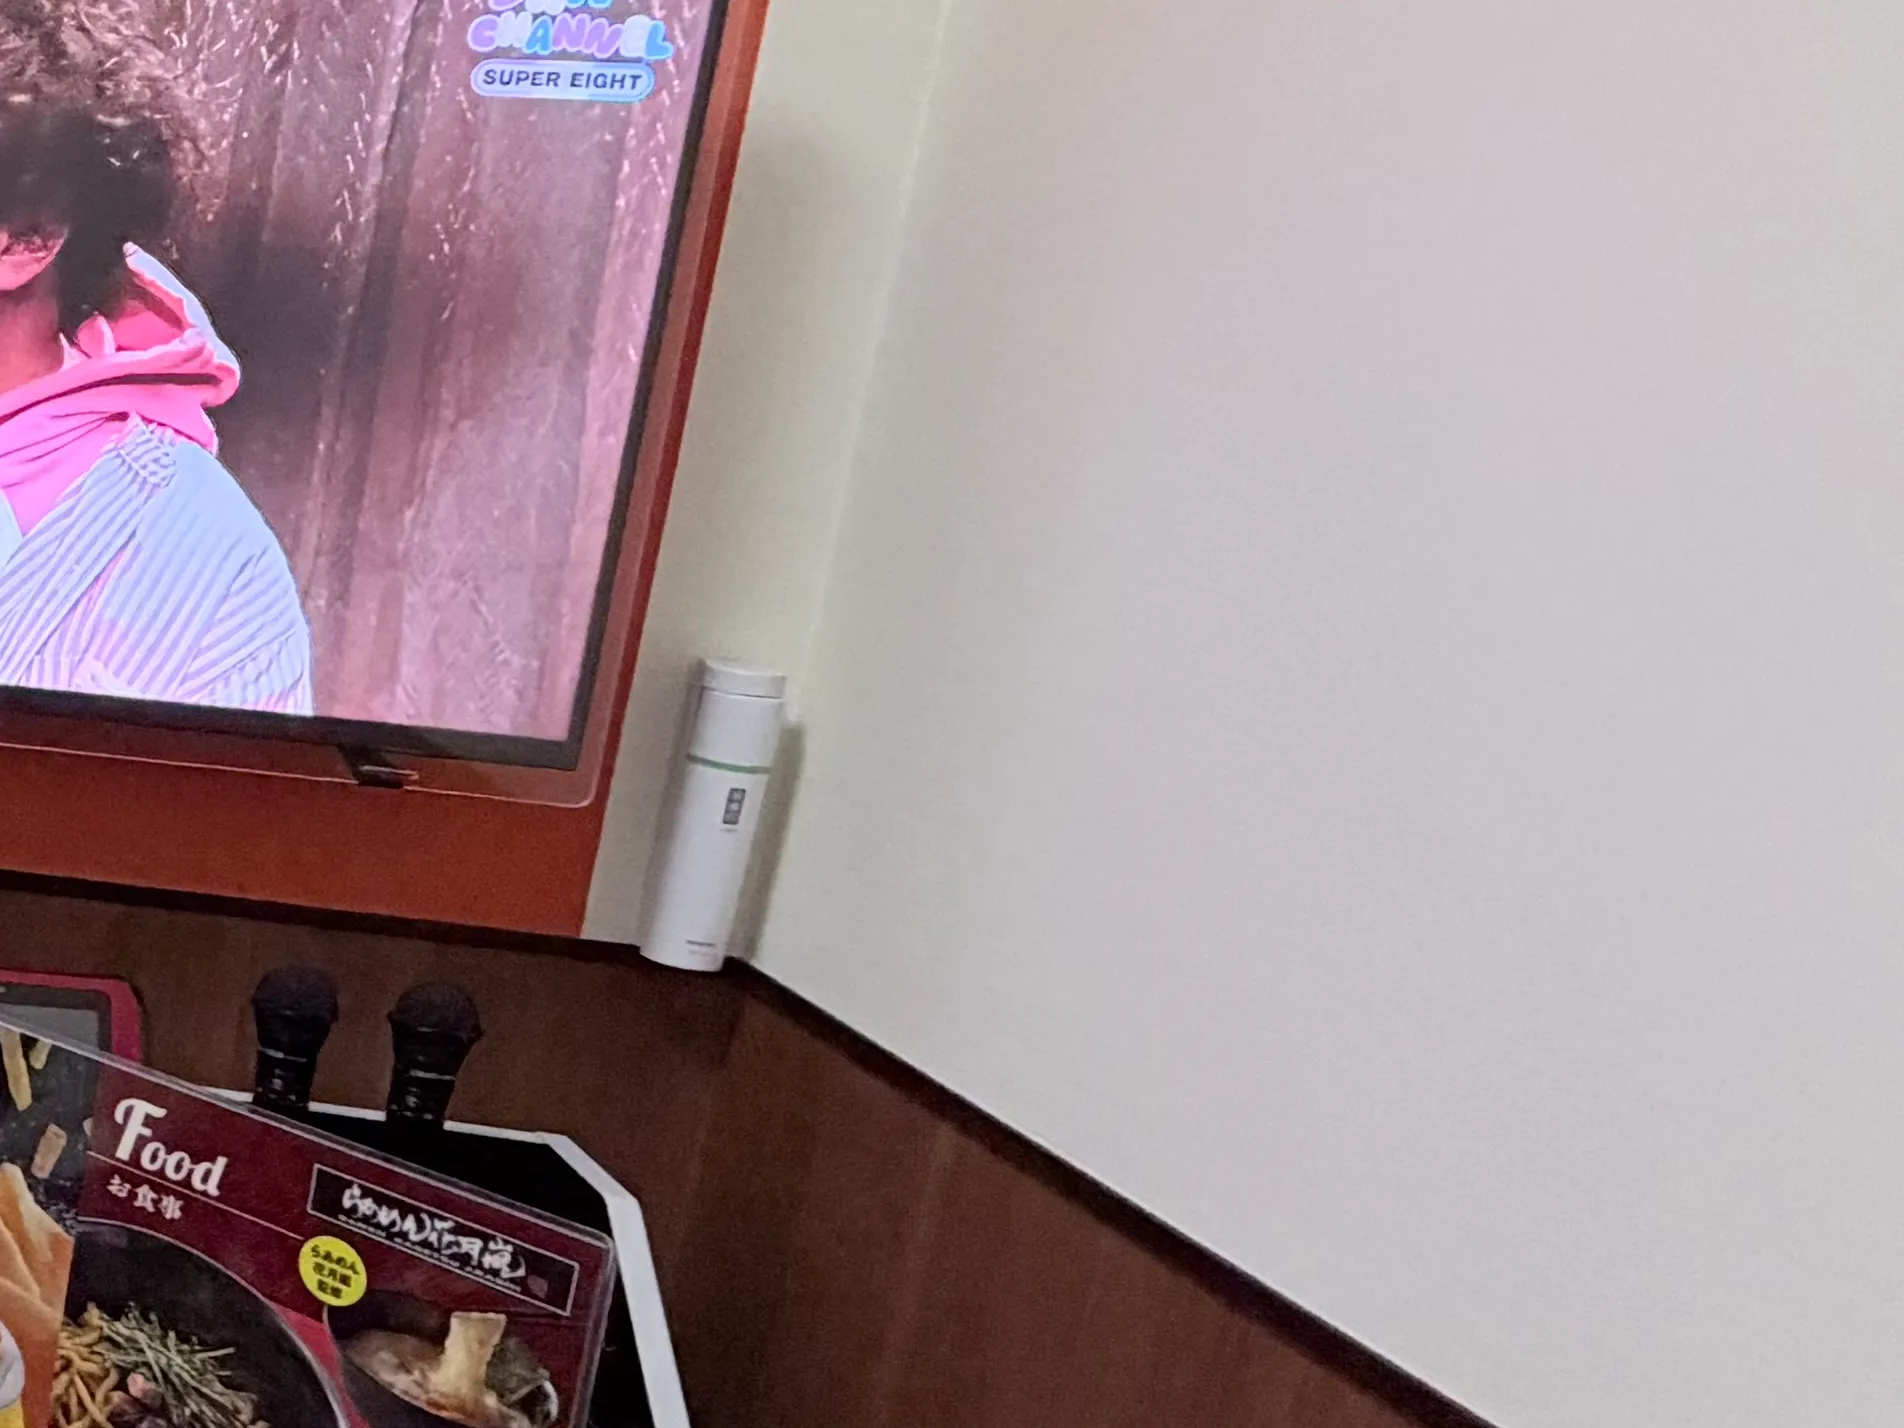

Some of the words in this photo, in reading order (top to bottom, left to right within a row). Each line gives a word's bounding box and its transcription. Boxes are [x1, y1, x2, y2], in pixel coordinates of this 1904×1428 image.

[467, 10, 674, 61] CHANNEL
[482, 68, 561, 88] SUPER
[570, 71, 643, 91] EIGHT
[112, 1096, 229, 1198] Food
[105, 1174, 185, 1221] お食事
